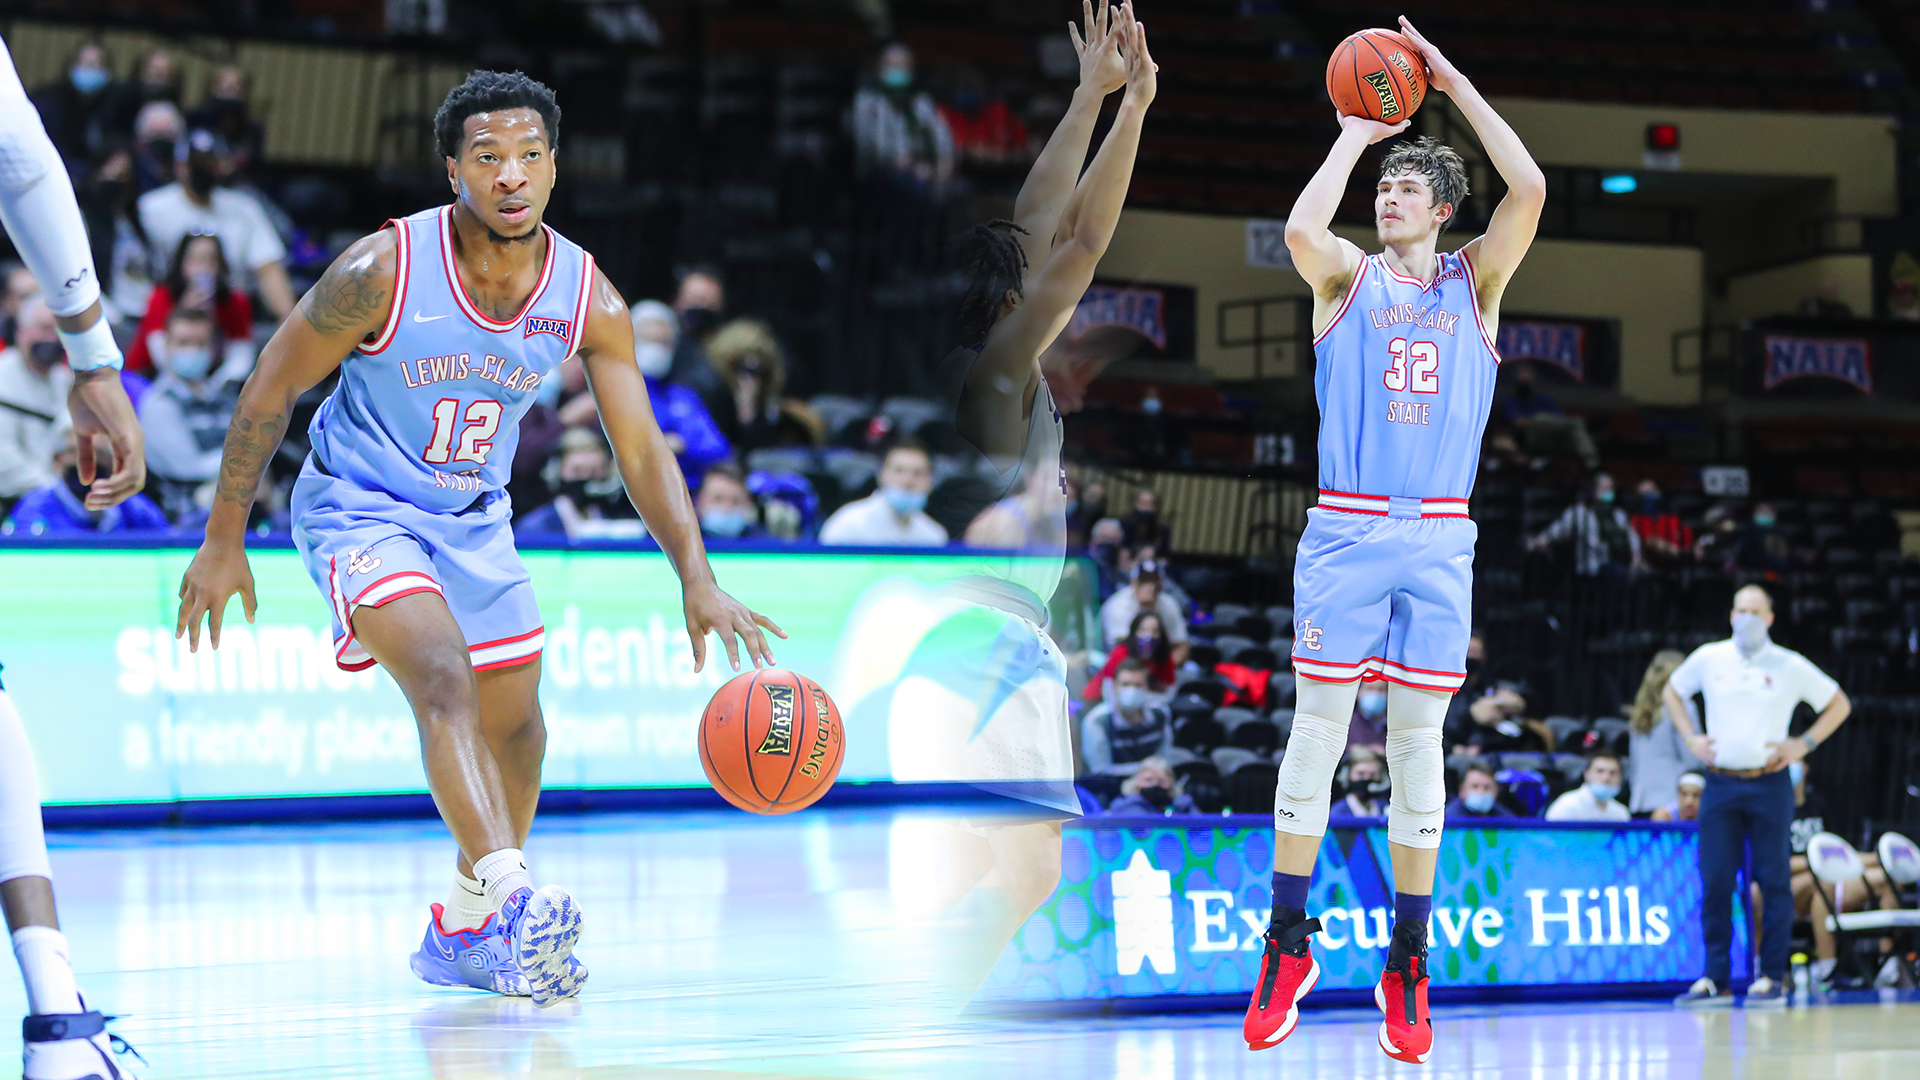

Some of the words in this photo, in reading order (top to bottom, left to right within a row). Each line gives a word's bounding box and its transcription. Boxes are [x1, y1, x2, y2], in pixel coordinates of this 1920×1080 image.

[1362, 70, 1400, 119] NAIA
[1252, 227, 1291, 264] 12
[526, 318, 570, 341] NAIA
[1383, 337, 1439, 394] 32
[1767, 338, 1869, 388] NAIA
[422, 397, 504, 465] 12
[1387, 400, 1431, 425] STATE
[1302, 618, 1324, 652] LC
[757, 684, 796, 756] NAIA
[1524, 885, 1671, 946] Hills
